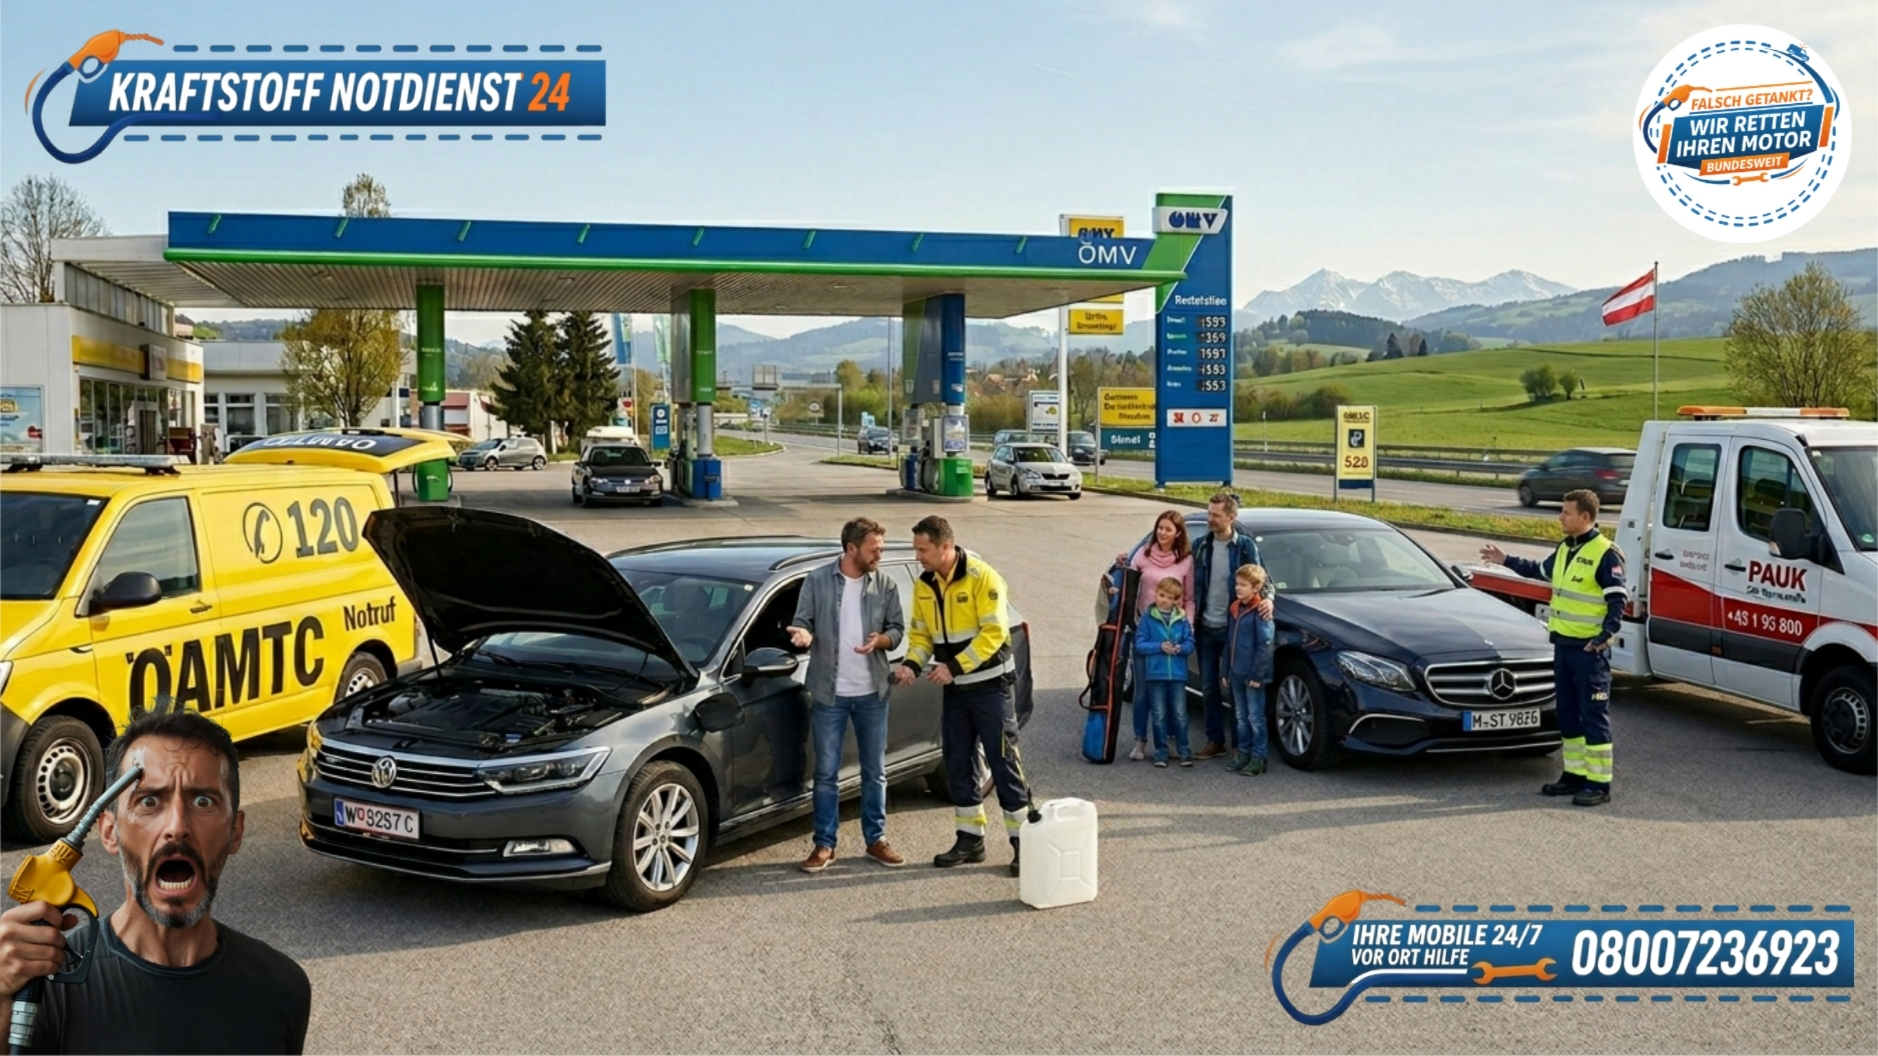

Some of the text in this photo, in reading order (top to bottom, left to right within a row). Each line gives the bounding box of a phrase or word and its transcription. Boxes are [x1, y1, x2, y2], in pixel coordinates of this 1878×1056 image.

[287, 497, 359, 559] 120
[1748, 560, 1808, 592] PAUK
[343, 596, 397, 632] Notruf
[1779, 617, 1803, 636] 800
[125, 615, 325, 718] ÖAMTC
